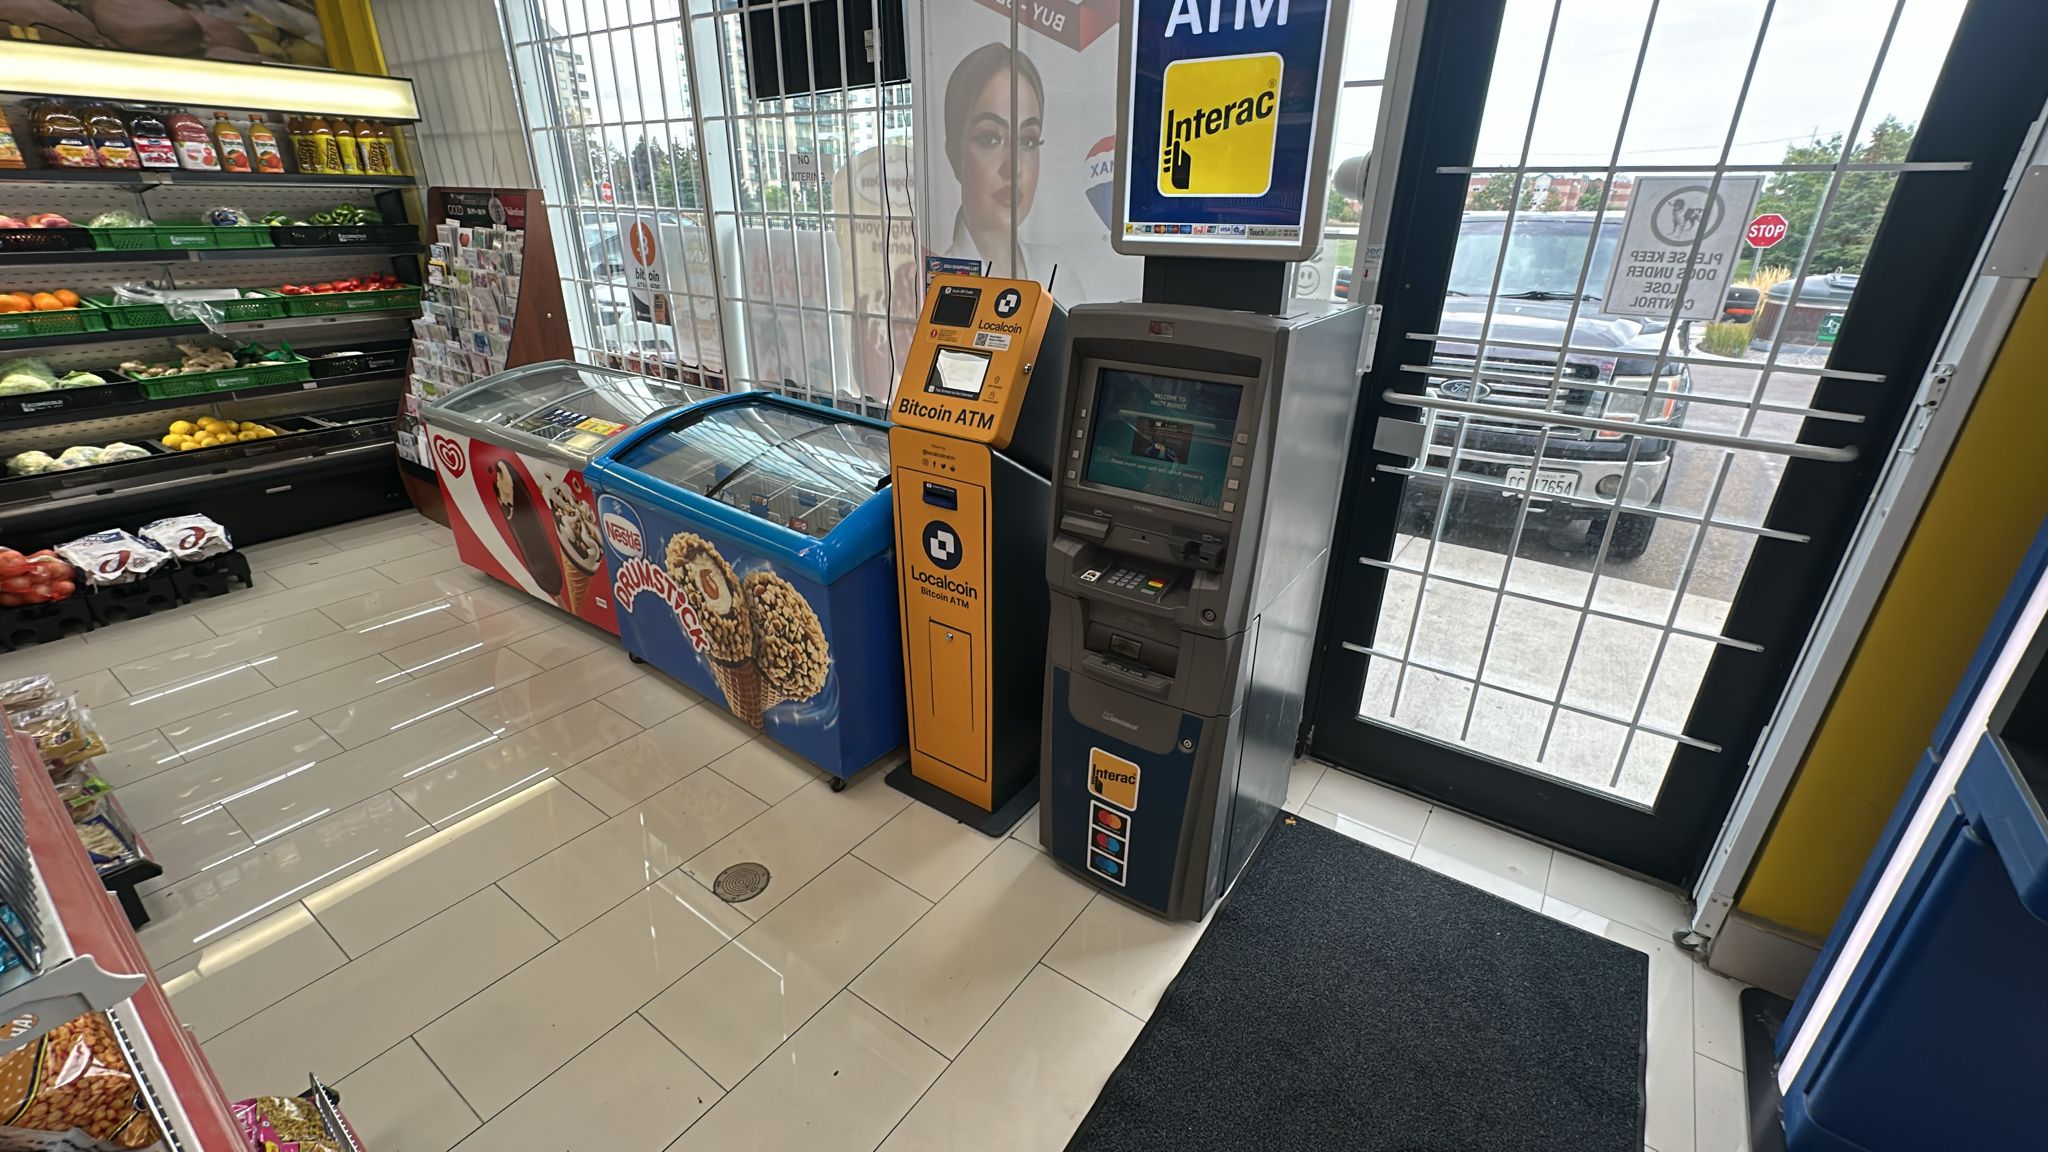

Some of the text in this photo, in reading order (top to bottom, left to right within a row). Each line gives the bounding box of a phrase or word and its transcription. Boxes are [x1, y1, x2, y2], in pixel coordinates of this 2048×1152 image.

[1164, 0, 1290, 38] ATM
[1166, 90, 1275, 148] Interac
[797, 154, 810, 165] NO
[785, 171, 826, 182] OITERING
[1749, 224, 1785, 238] STOP
[636, 268, 660, 282] bitoin
[978, 319, 1022, 334] Localcoin
[898, 398, 995, 430] Bitcoin ATM
[605, 520, 642, 551] Nestlé
[911, 565, 978, 600] Localcoin
[615, 559, 709, 651] DRUMSTICK
[920, 586, 969, 609] Bitcoin ATM
[1092, 763, 1136, 786] Interac
